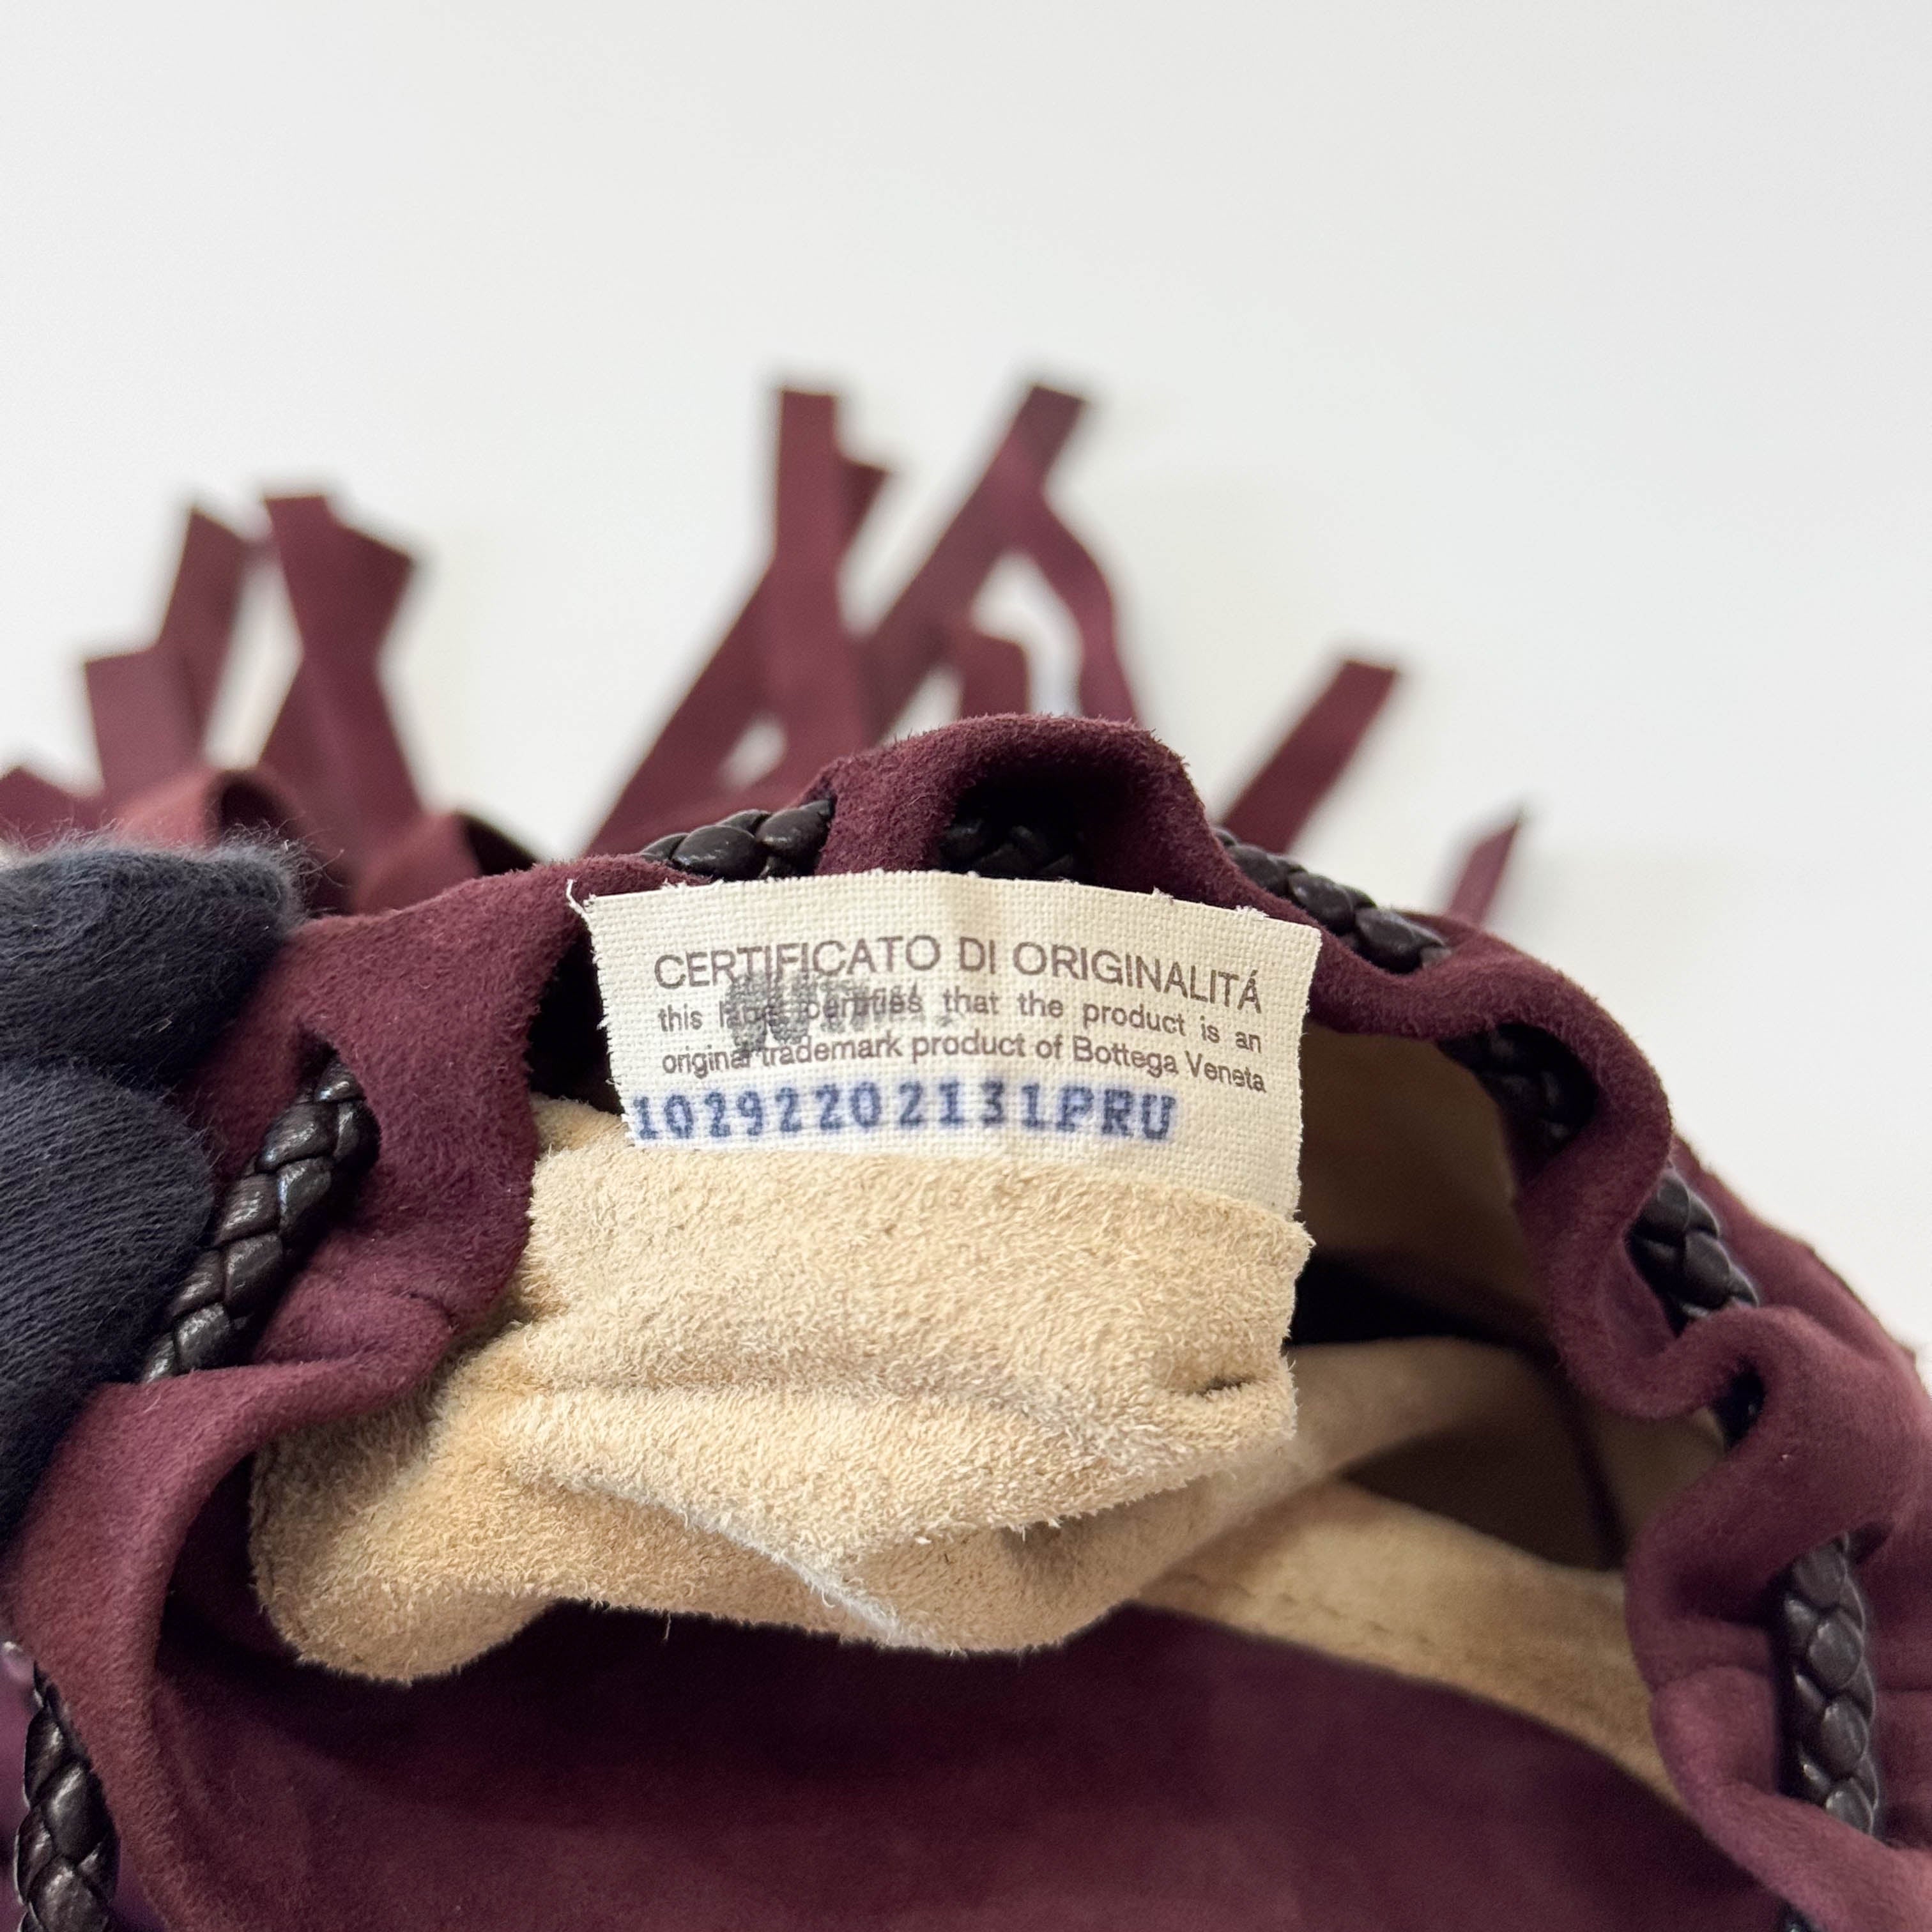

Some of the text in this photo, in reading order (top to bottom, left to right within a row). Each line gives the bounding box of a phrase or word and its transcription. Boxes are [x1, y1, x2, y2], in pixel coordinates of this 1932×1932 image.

[654, 934, 941, 990] CERTIFICATO
[959, 936, 997, 975] DI
[657, 1002, 702, 1032] this
[942, 986, 1000, 1016] that
[1017, 990, 1064, 1018] the
[1082, 1003, 1186, 1037] product
[1201, 1016, 1220, 1044] is
[1234, 1029, 1262, 1054] an
[762, 1031, 903, 1067] trademark
[912, 1029, 1025, 1065] product
[1035, 1034, 1064, 1059] of
[1072, 1035, 1178, 1078] Bottega
[1184, 1050, 1267, 1093] Veneta
